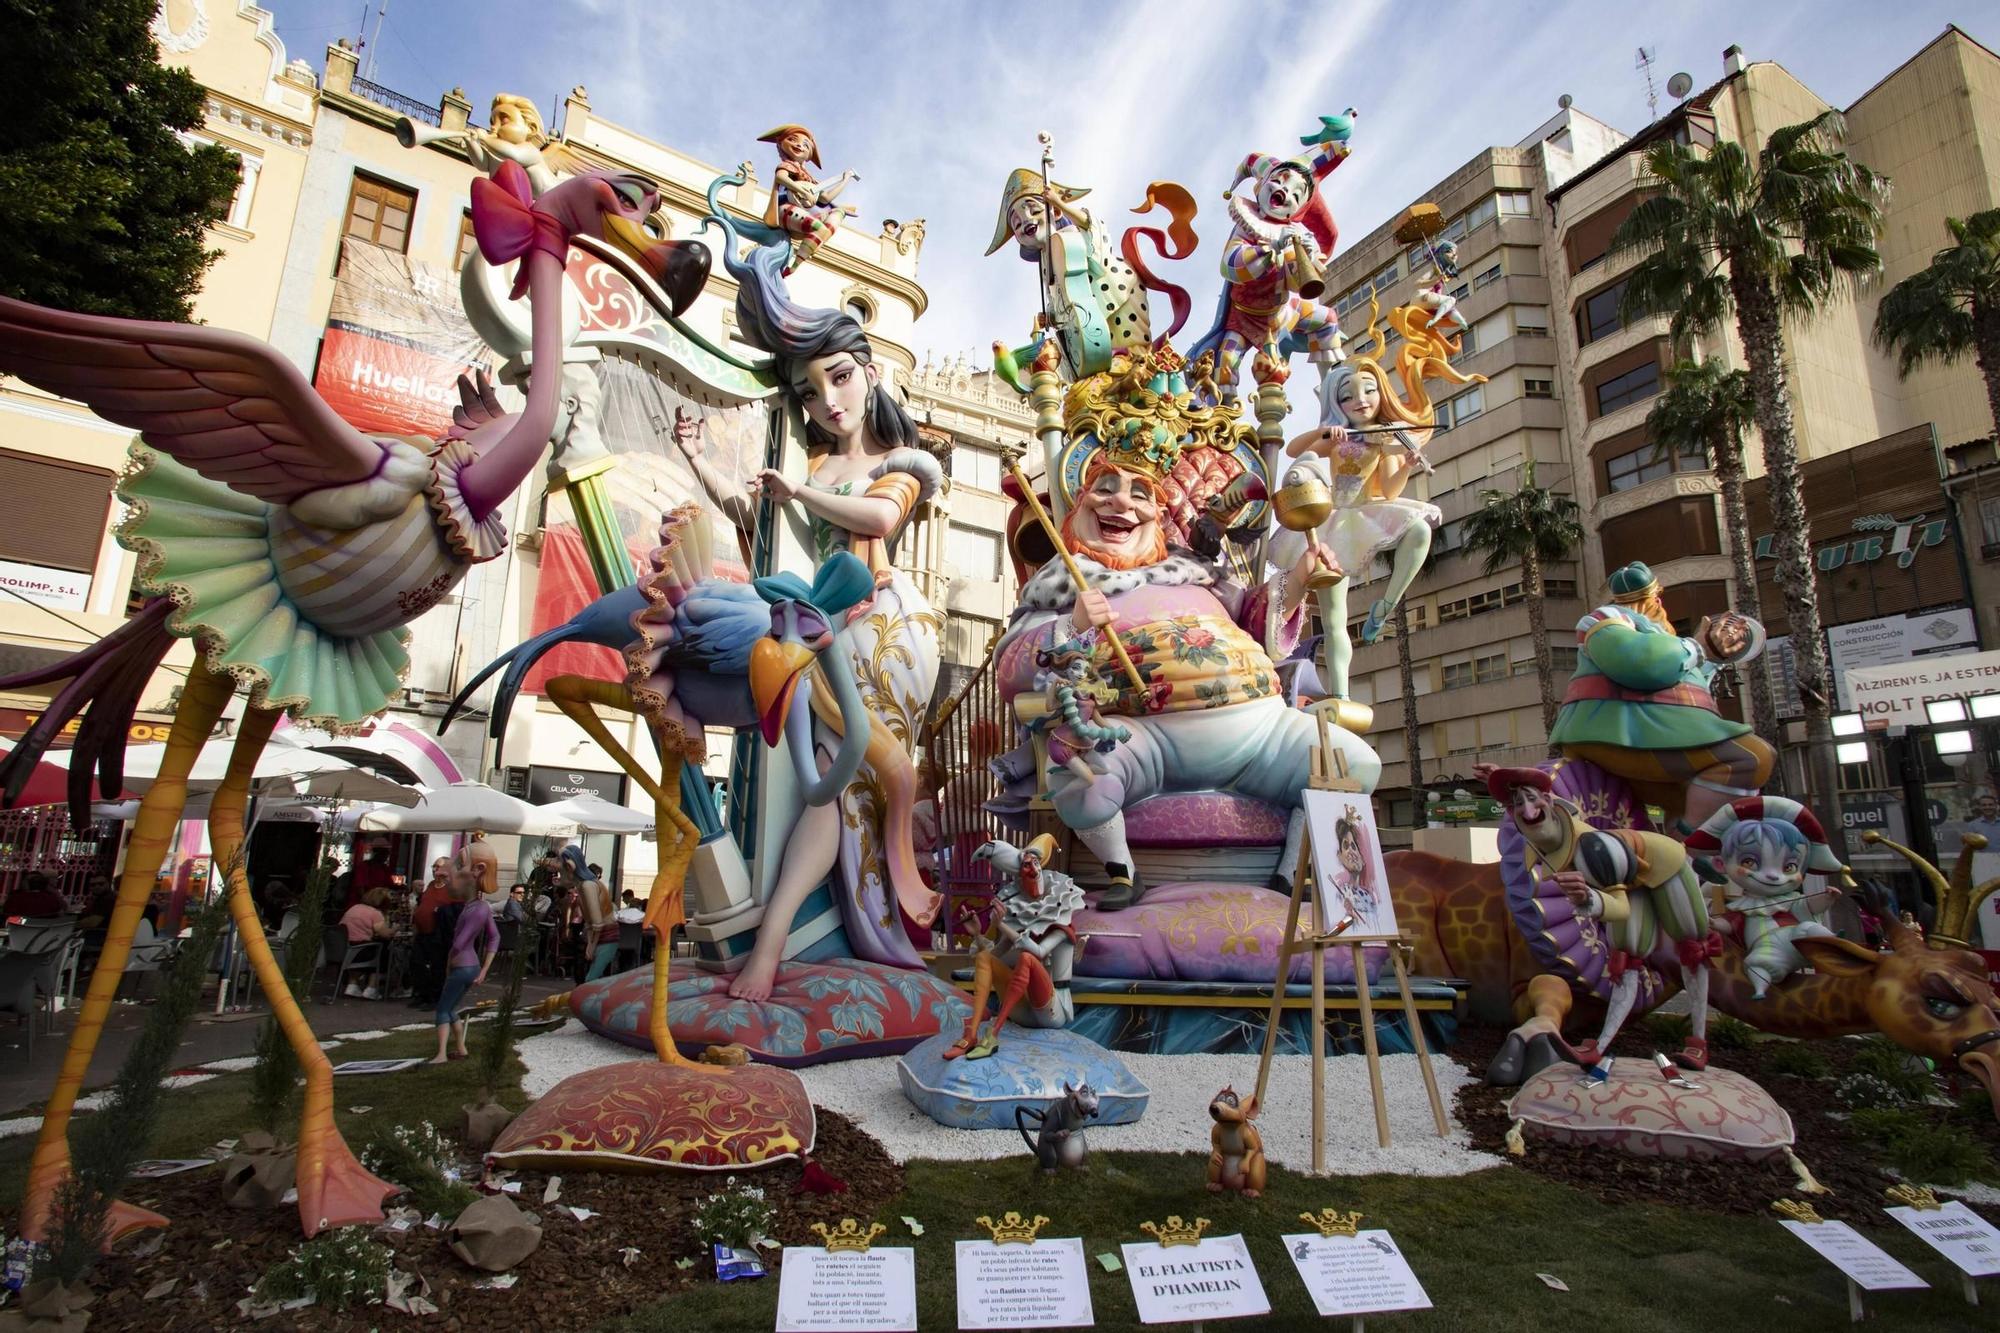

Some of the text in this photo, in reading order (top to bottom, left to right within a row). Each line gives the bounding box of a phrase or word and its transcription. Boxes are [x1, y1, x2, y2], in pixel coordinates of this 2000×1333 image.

[58, 586, 80, 596] S.L.
[1935, 672, 1952, 682] JA
[1859, 697, 1914, 716] MOLT
[1139, 1259, 1244, 1277] EL FLAUTISTA
